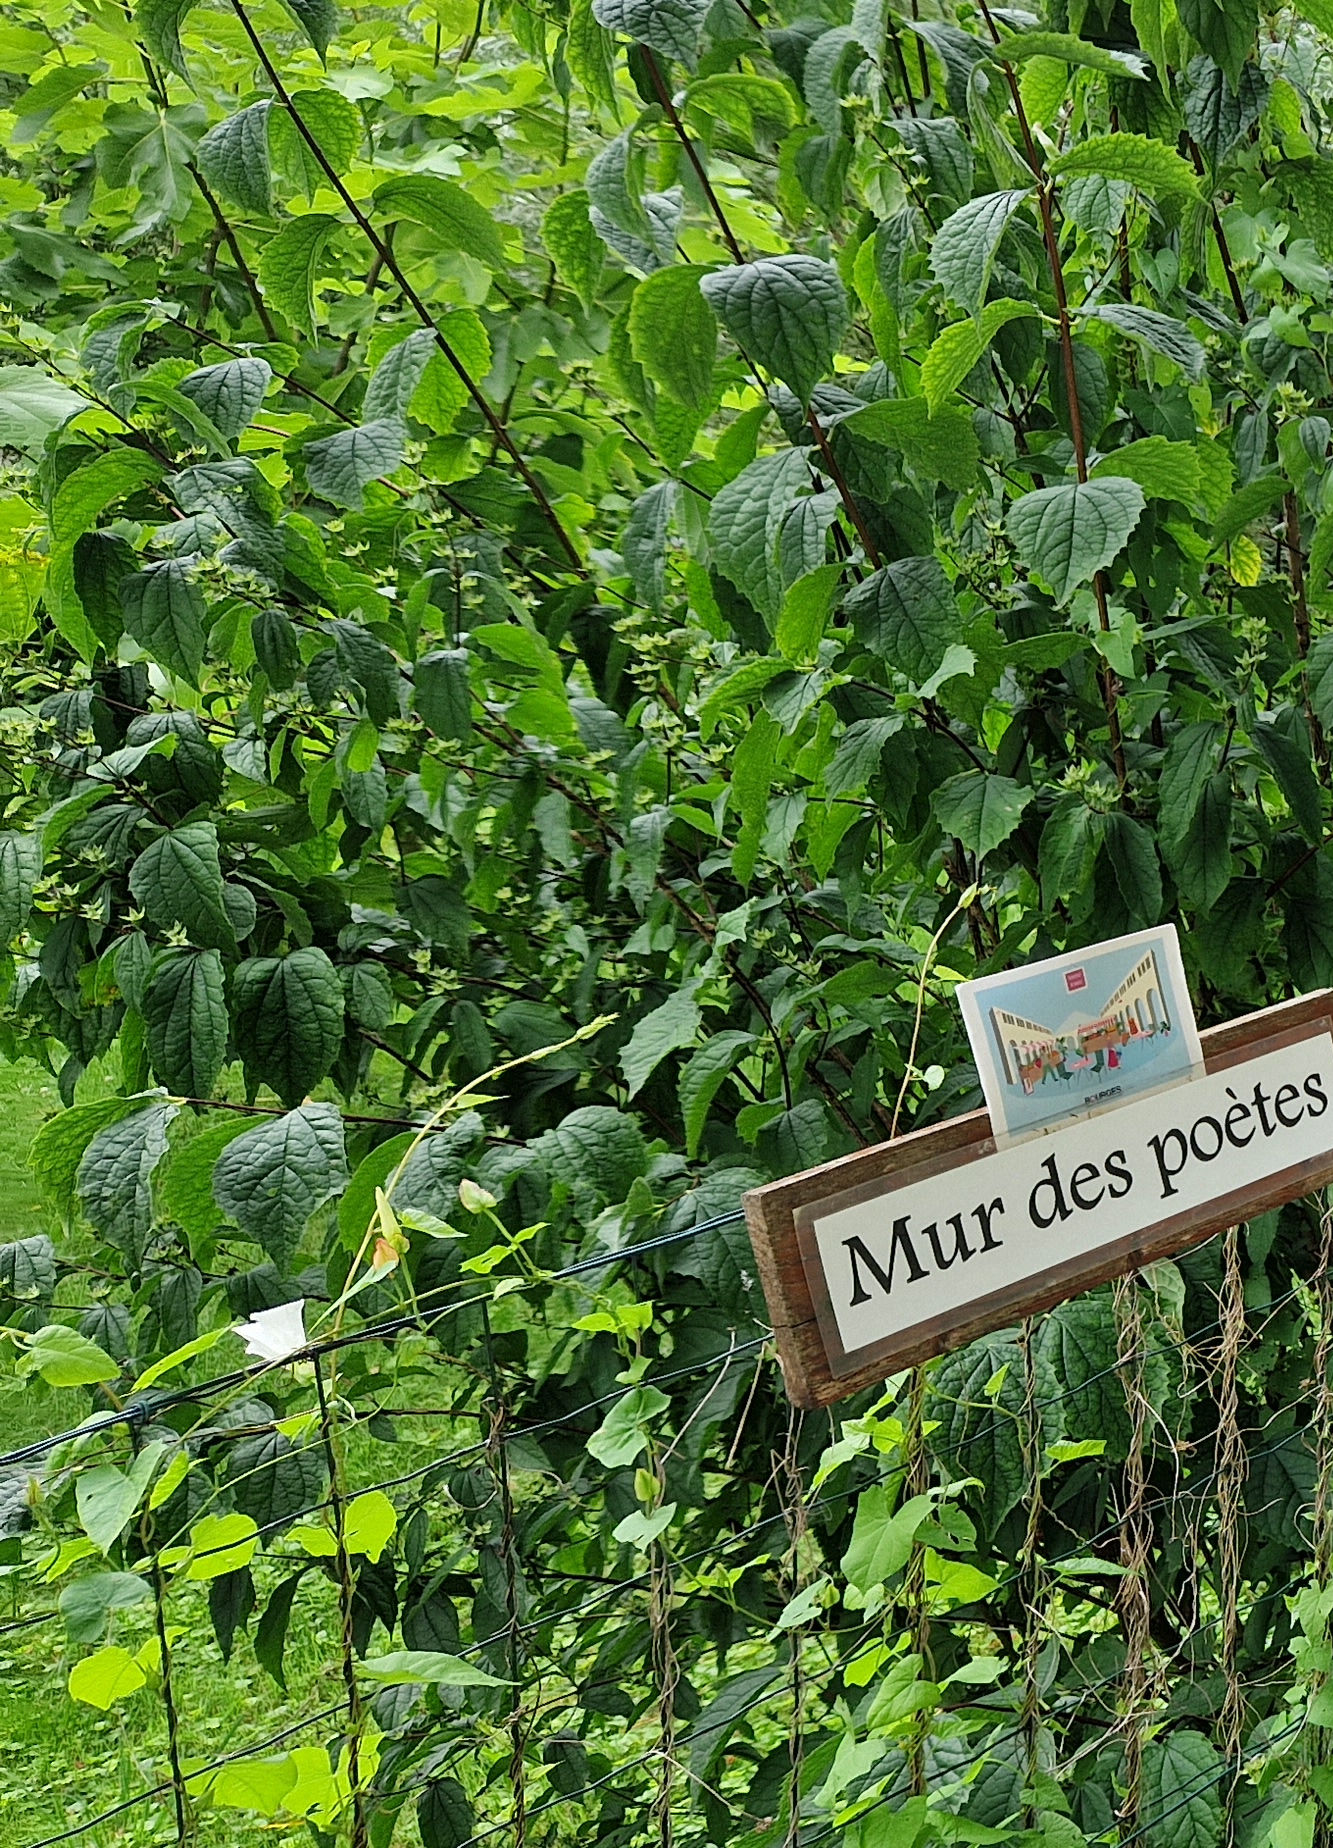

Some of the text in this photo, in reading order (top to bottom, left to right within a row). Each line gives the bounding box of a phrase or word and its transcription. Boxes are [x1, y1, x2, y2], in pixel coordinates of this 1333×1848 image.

[1085, 1085, 1122, 1104] BOURGES
[842, 1072, 1329, 1307] Mur des poètes
